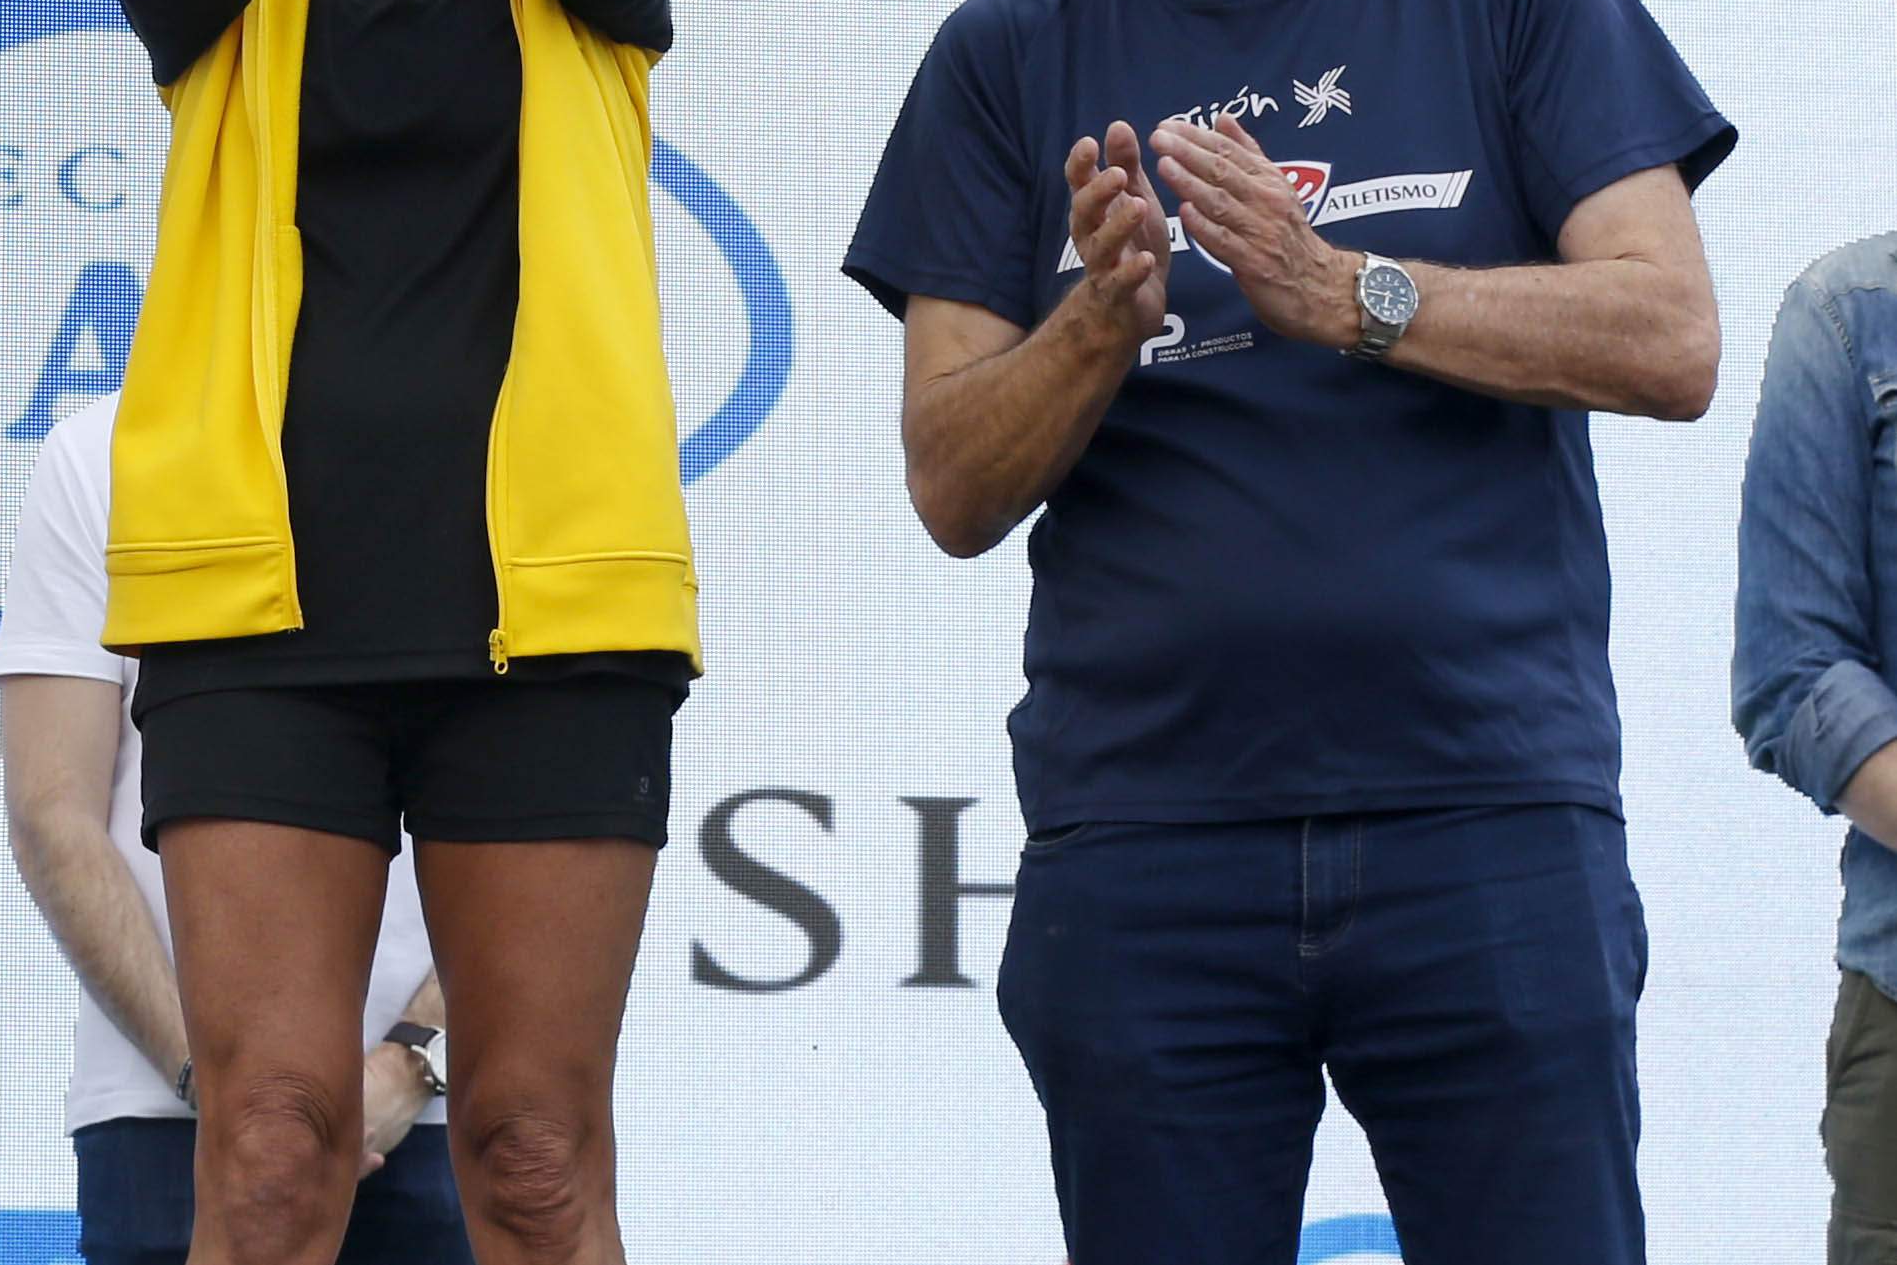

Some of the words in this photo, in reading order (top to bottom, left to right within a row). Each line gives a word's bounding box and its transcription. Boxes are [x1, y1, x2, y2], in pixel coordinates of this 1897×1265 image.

[1326, 184, 1437, 213] ATLETISMO
[1201, 332, 1253, 348] PRODUCTOS
[1157, 354, 1180, 363] PARA
[1181, 352, 1191, 360] LA
